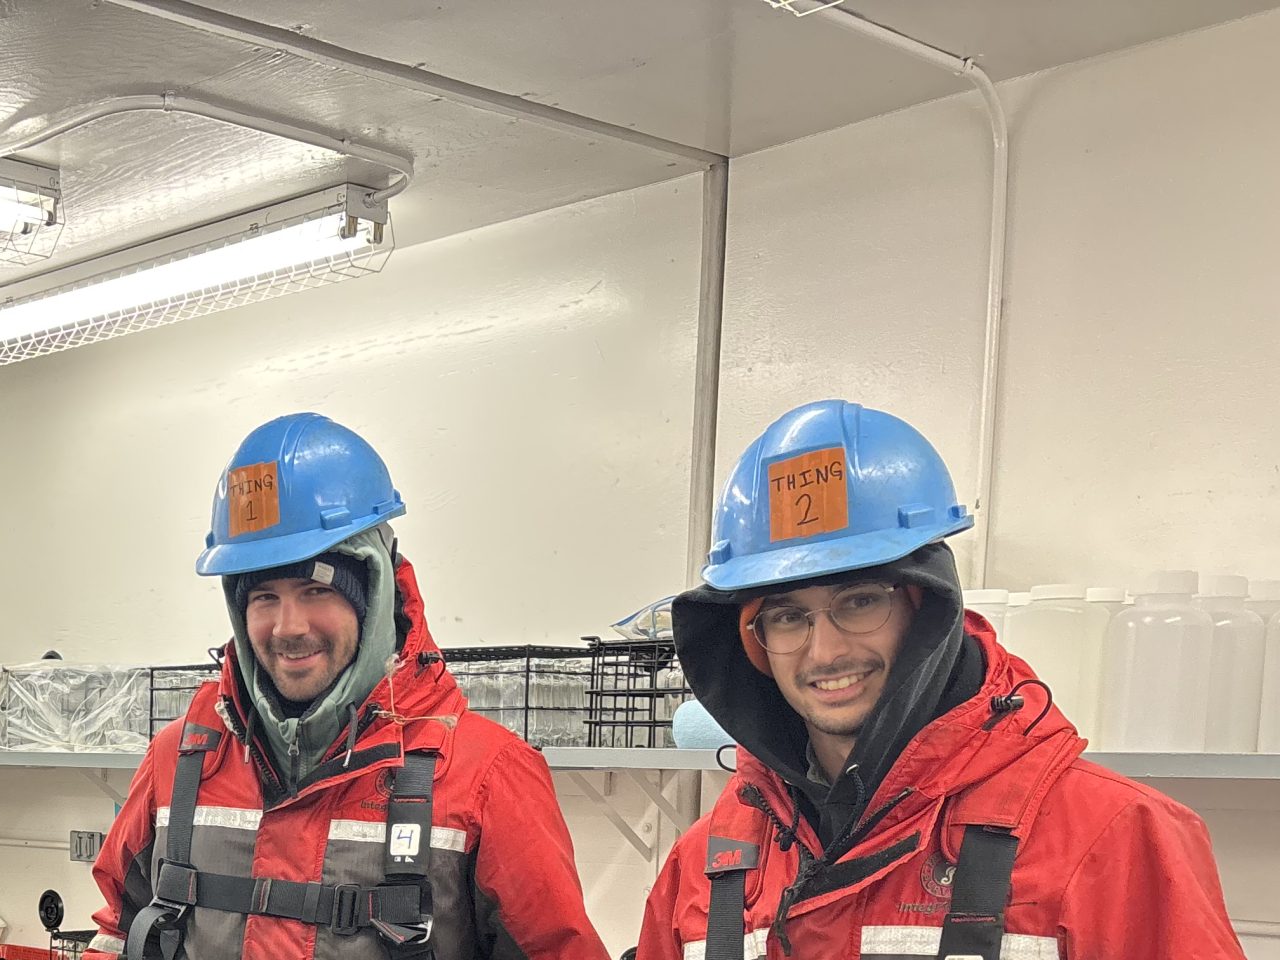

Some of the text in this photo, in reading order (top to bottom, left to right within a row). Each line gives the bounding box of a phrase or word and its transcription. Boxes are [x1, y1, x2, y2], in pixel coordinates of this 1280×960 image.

[230, 473, 273, 497] THING
[771, 461, 842, 492] THING
[246, 500, 257, 521] 1
[795, 493, 819, 526] 2
[184, 732, 209, 746] 3M
[397, 828, 414, 849] 4
[712, 849, 742, 868] 3M
